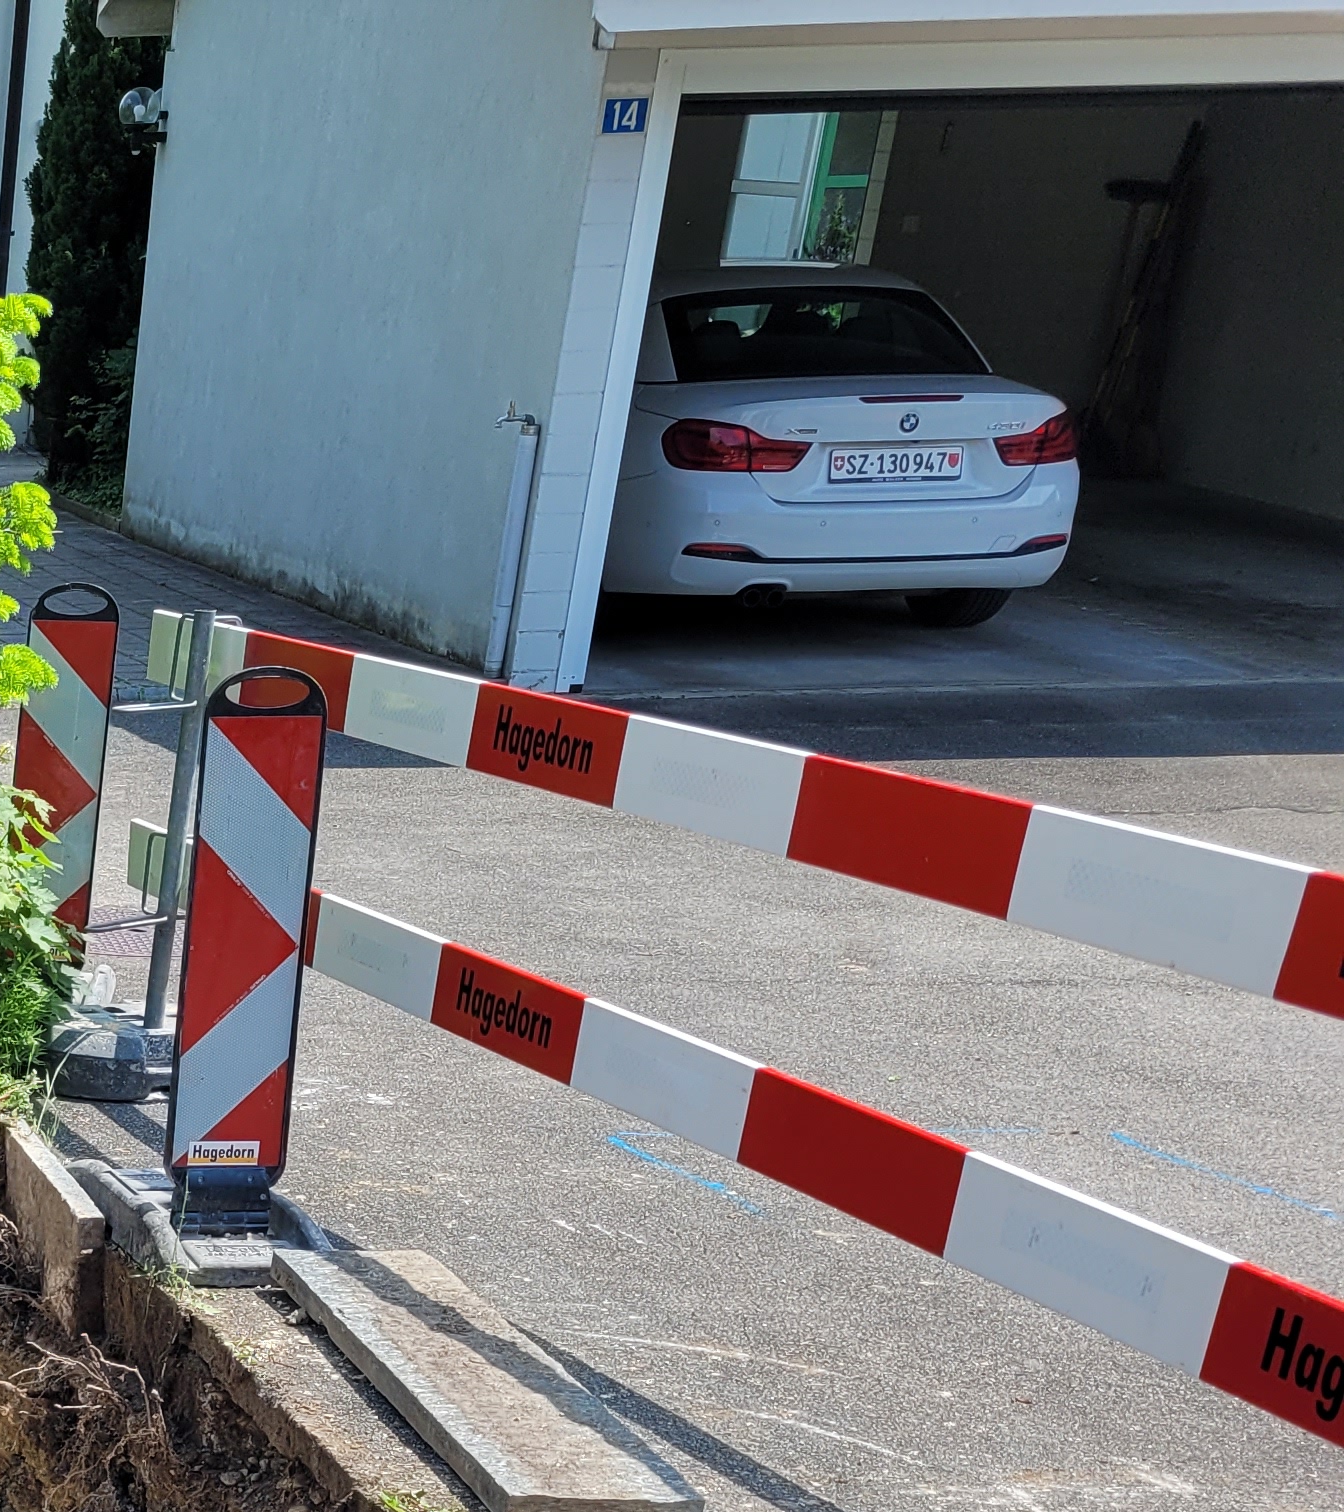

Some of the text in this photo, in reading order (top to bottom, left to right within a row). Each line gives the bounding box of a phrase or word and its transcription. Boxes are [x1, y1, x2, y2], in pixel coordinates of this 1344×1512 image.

[612, 100, 639, 131] 14
[493, 702, 597, 776] Hagedorn
[455, 965, 554, 1050] Hagedorn
[193, 1144, 255, 1162] Hagedorn
